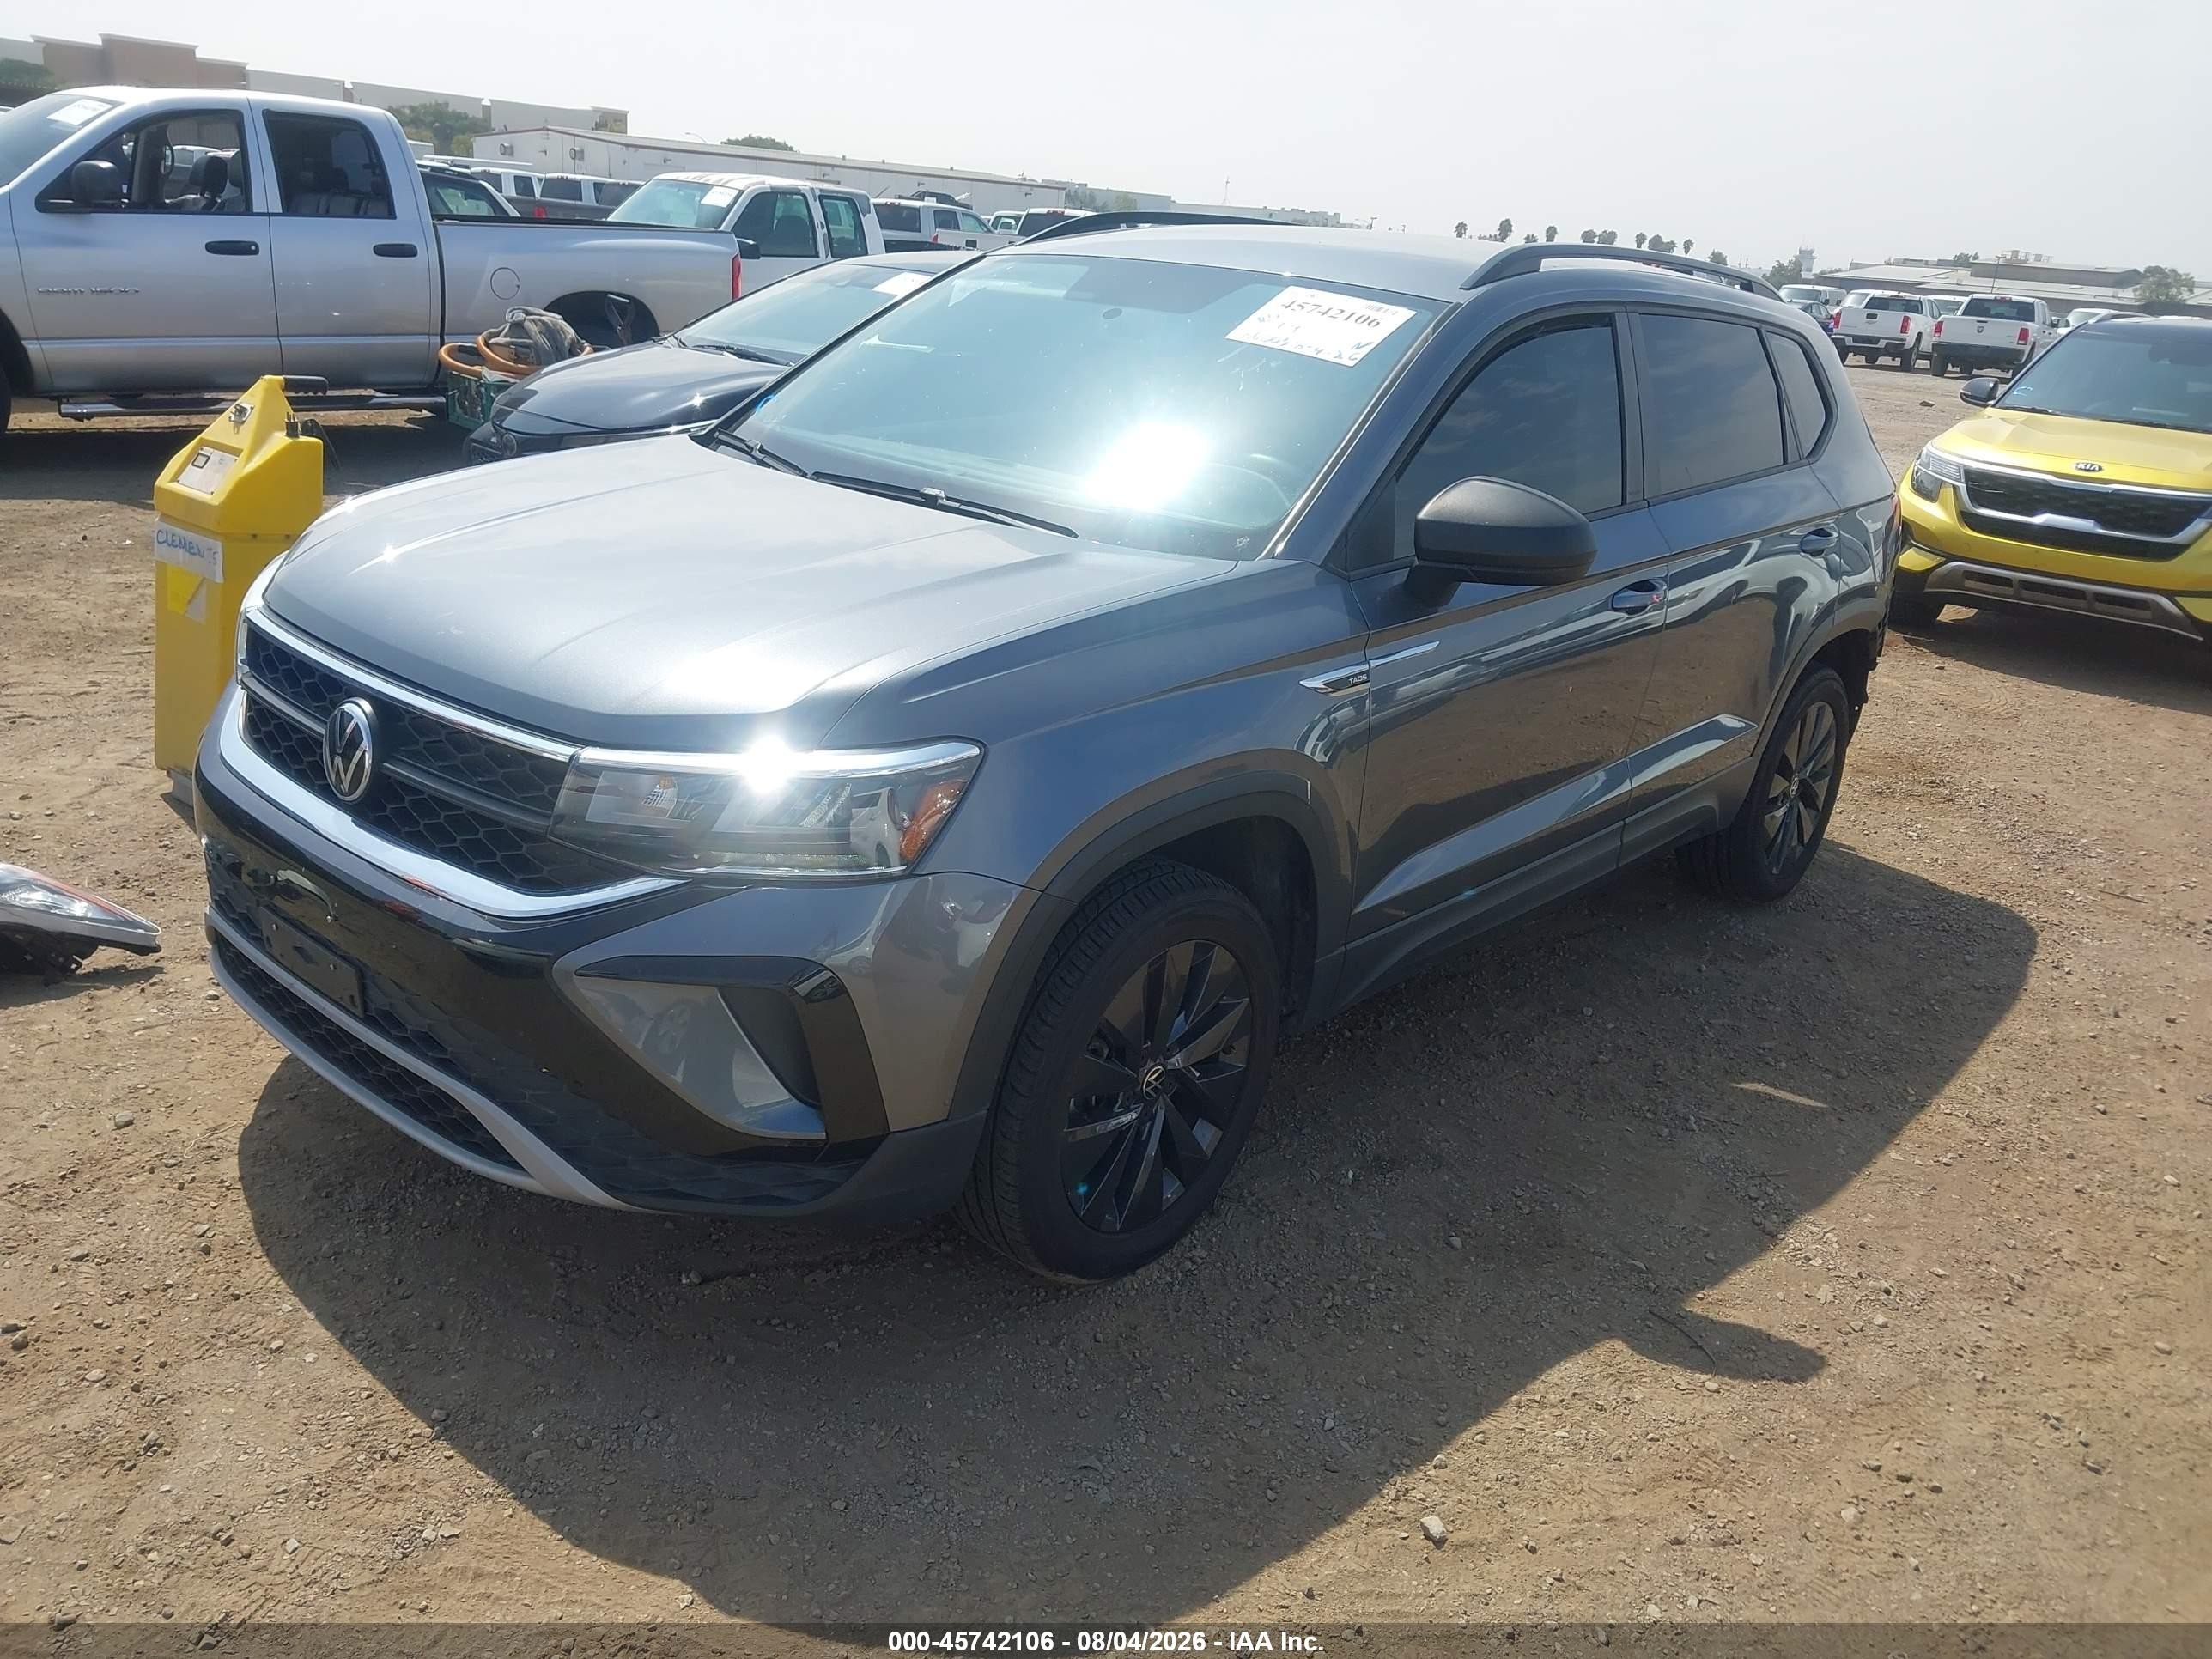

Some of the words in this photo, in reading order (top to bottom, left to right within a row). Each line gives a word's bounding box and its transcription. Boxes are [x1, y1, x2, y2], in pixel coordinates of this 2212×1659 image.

[1280, 300, 1382, 328] 45742106
[2075, 463, 2100, 471] KIA
[1349, 673, 1368, 685] TAOS
